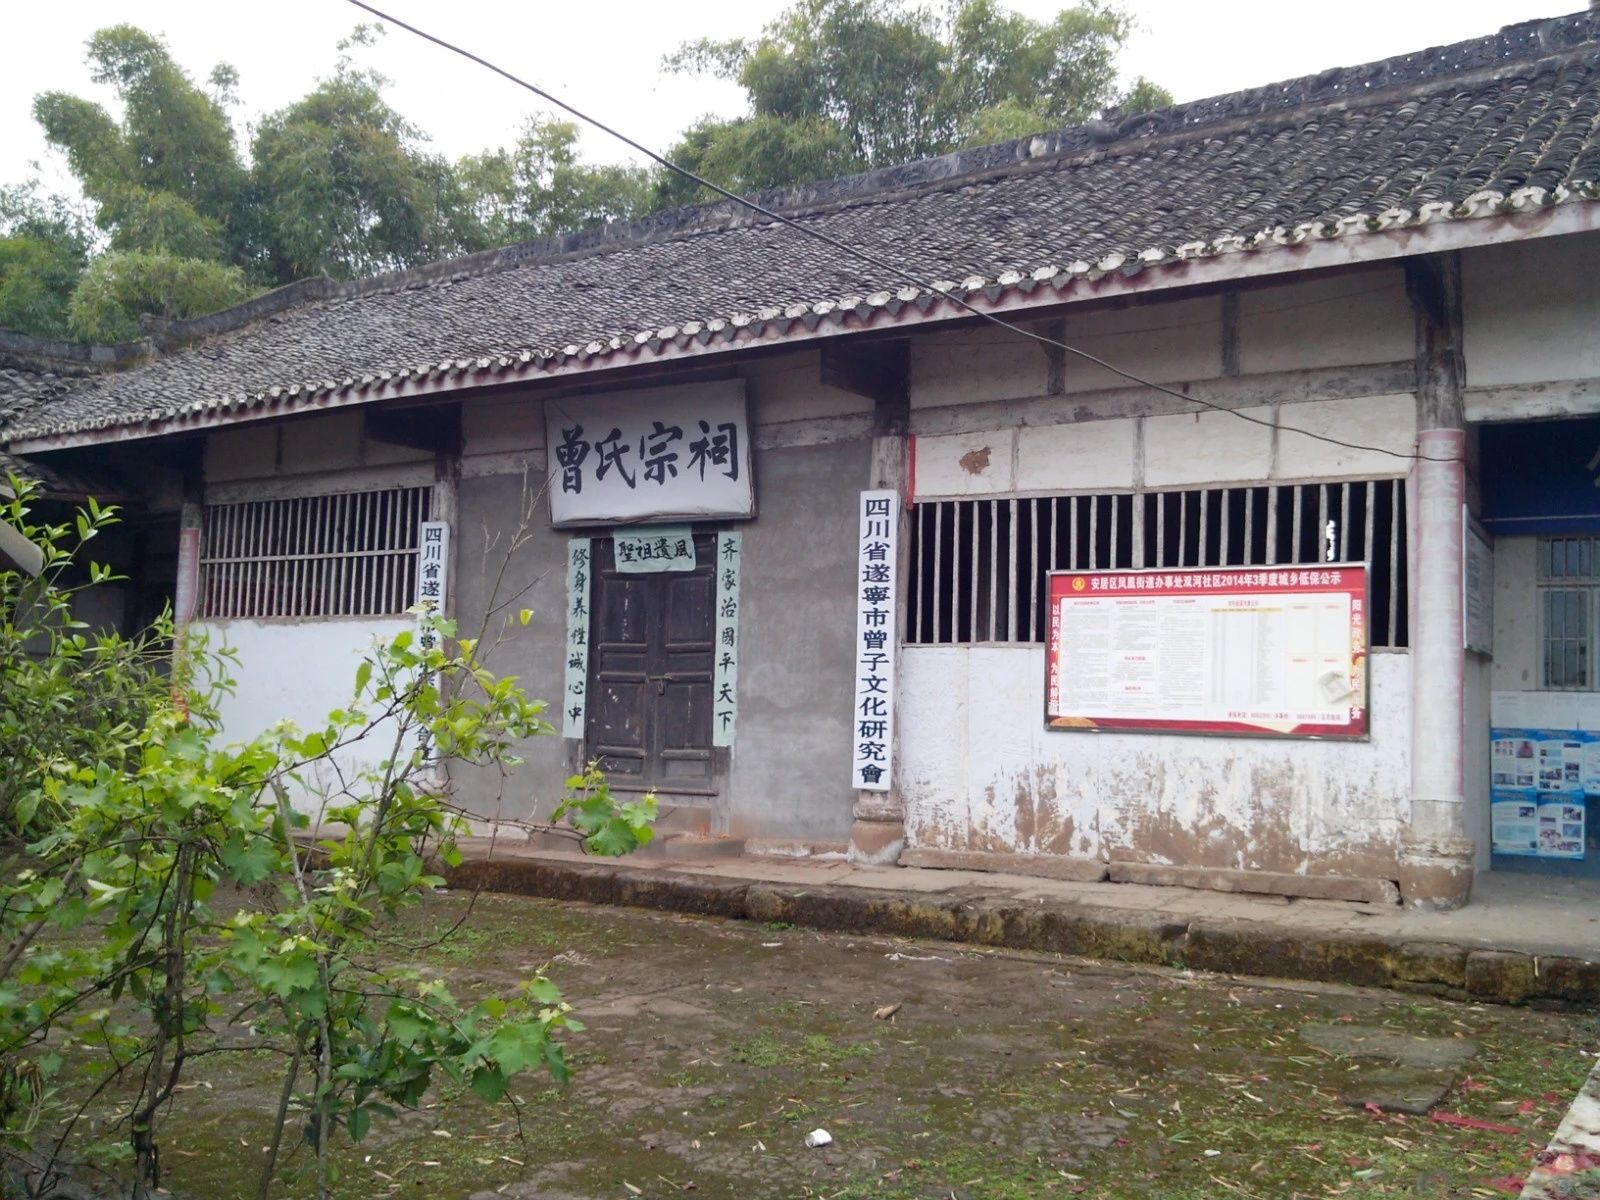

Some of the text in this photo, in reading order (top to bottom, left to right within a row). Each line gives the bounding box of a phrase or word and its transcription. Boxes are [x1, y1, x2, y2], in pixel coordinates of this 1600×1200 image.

[555, 420, 738, 494] 曾氏宗祠
[858, 498, 890, 784] 四川省遂寧市曾子文化研究會
